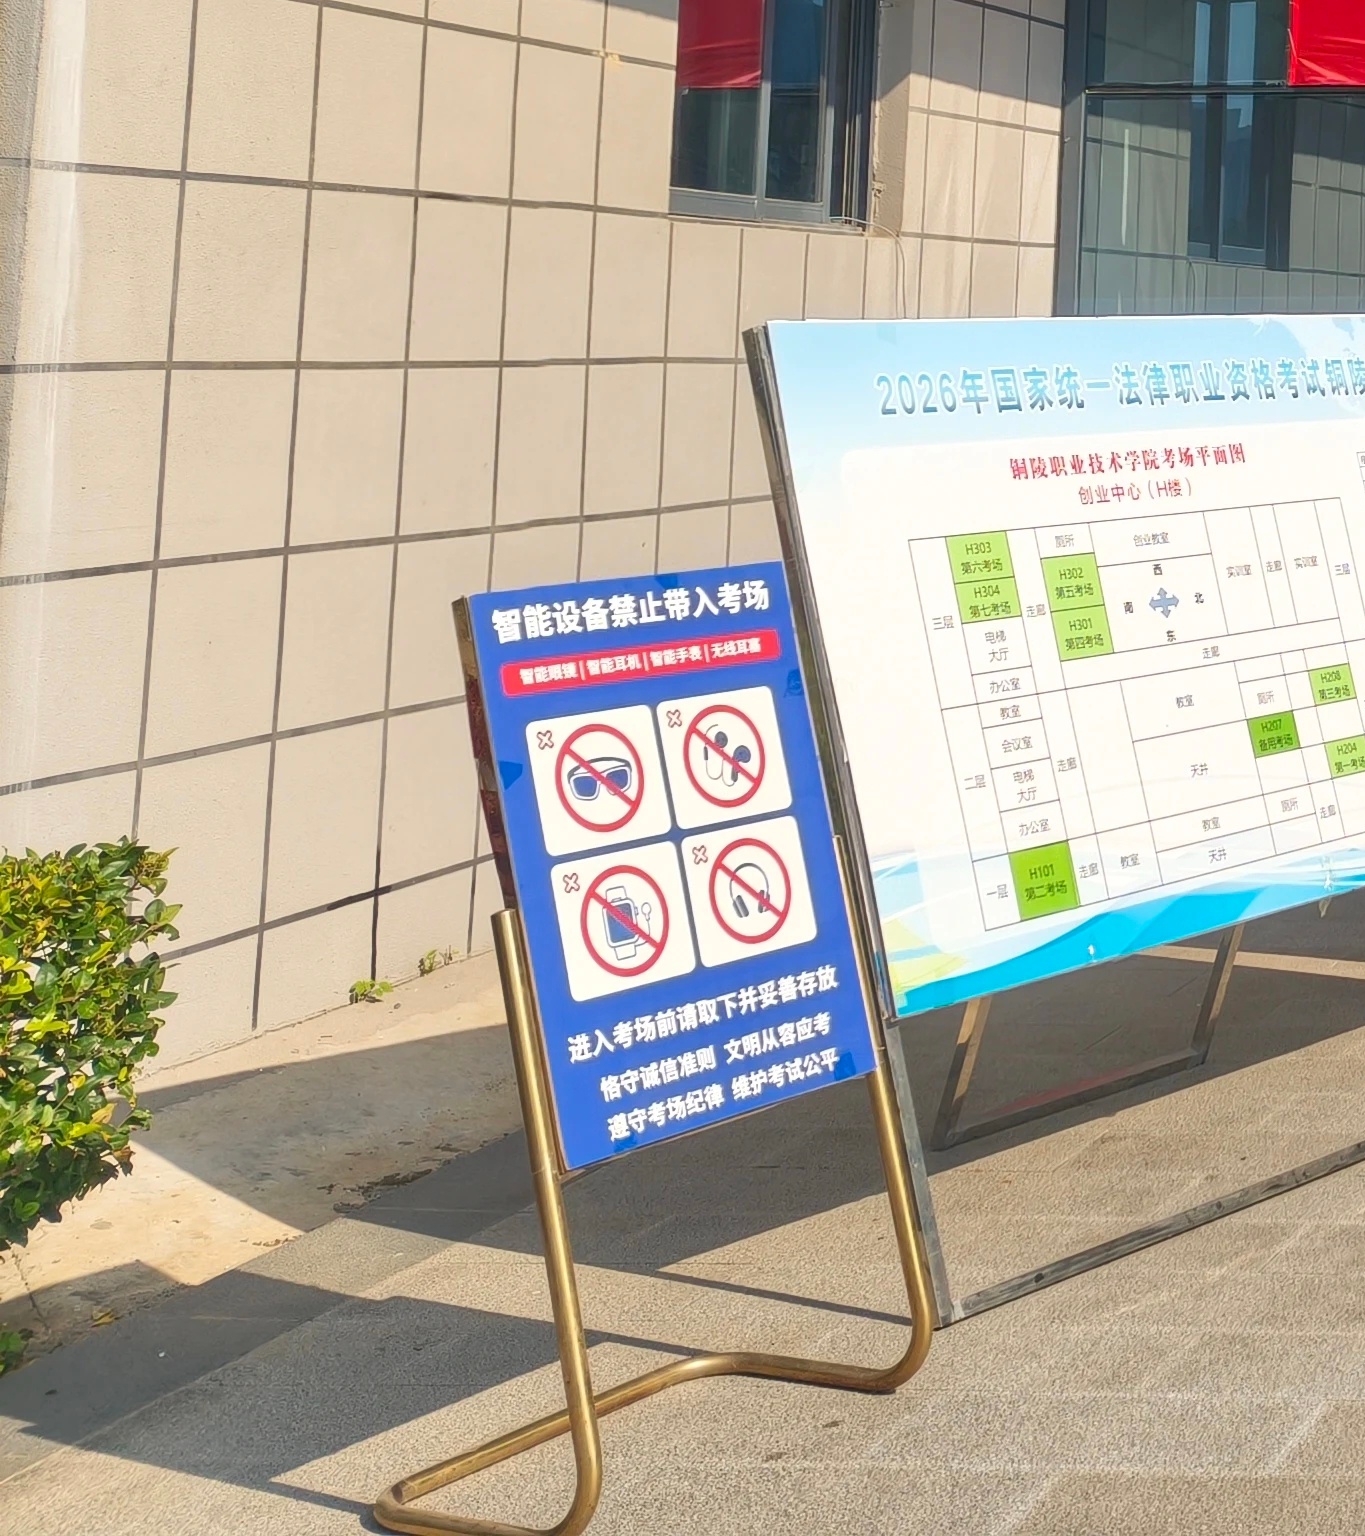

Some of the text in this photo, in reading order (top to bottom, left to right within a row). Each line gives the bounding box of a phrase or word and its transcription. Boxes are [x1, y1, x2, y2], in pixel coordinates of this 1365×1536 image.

[1009, 442, 1246, 481] 铜陵职业技术学院考场平面图
[964, 541, 993, 555] H303
[960, 558, 1004, 576] 第六考场
[1058, 567, 1085, 581] H302
[973, 584, 1001, 599] H304
[1054, 583, 1094, 600] 第五考场
[491, 579, 770, 645] 智能设备禁止带入考场
[968, 600, 1012, 619] 第七考场
[931, 615, 955, 630] 三层
[1068, 617, 1093, 631] H301
[984, 630, 1007, 645] 电梯
[1064, 633, 1105, 652] 第四考场
[987, 647, 1009, 663] 大厅
[519, 661, 578, 686] 智能眼镜
[586, 653, 642, 676] 智能耳机
[649, 645, 703, 667] 智能手表
[988, 677, 1022, 694] 办公室
[1260, 718, 1283, 733] H207
[1001, 735, 1034, 754] 会议室
[1336, 743, 1359, 756] H204
[963, 773, 987, 791] 二层
[1012, 768, 1035, 784] 电梯
[1016, 785, 1038, 802] 大厅
[1018, 818, 1051, 837] 办公室
[1028, 862, 1056, 880] H101
[985, 883, 1010, 900] 一层
[1024, 879, 1068, 903] 第二考场
[566, 963, 840, 1065] 进入考场前请取下并妥善存放
[600, 1011, 832, 1103] 恪守诚信准则 文明从容应考
[606, 1047, 840, 1143] 遵守考场纪律 维护考试公平
